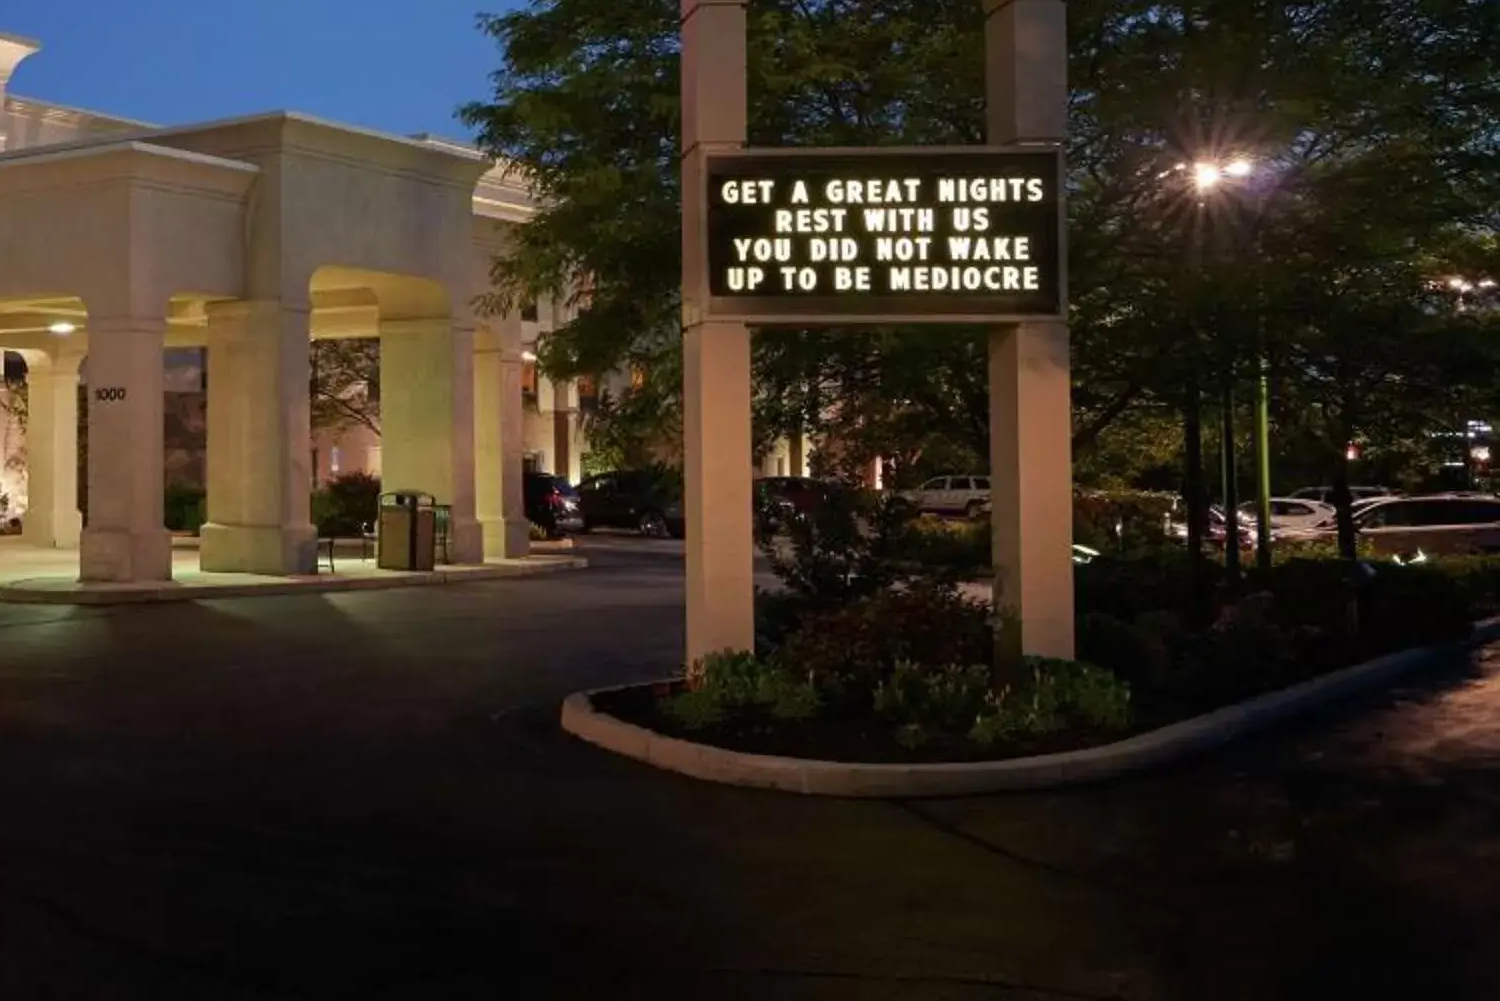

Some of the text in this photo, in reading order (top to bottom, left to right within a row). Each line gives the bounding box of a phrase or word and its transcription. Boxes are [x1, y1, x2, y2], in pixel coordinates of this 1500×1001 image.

[720, 178, 1044, 204] GET A GREAT NIGHTS
[775, 207, 990, 233] REST WITH US
[733, 236, 1030, 262] YOU DID NOT WAKE
[727, 266, 1040, 291] UP TO BE MEDIOCRE
[94, 386, 127, 401] 1000
